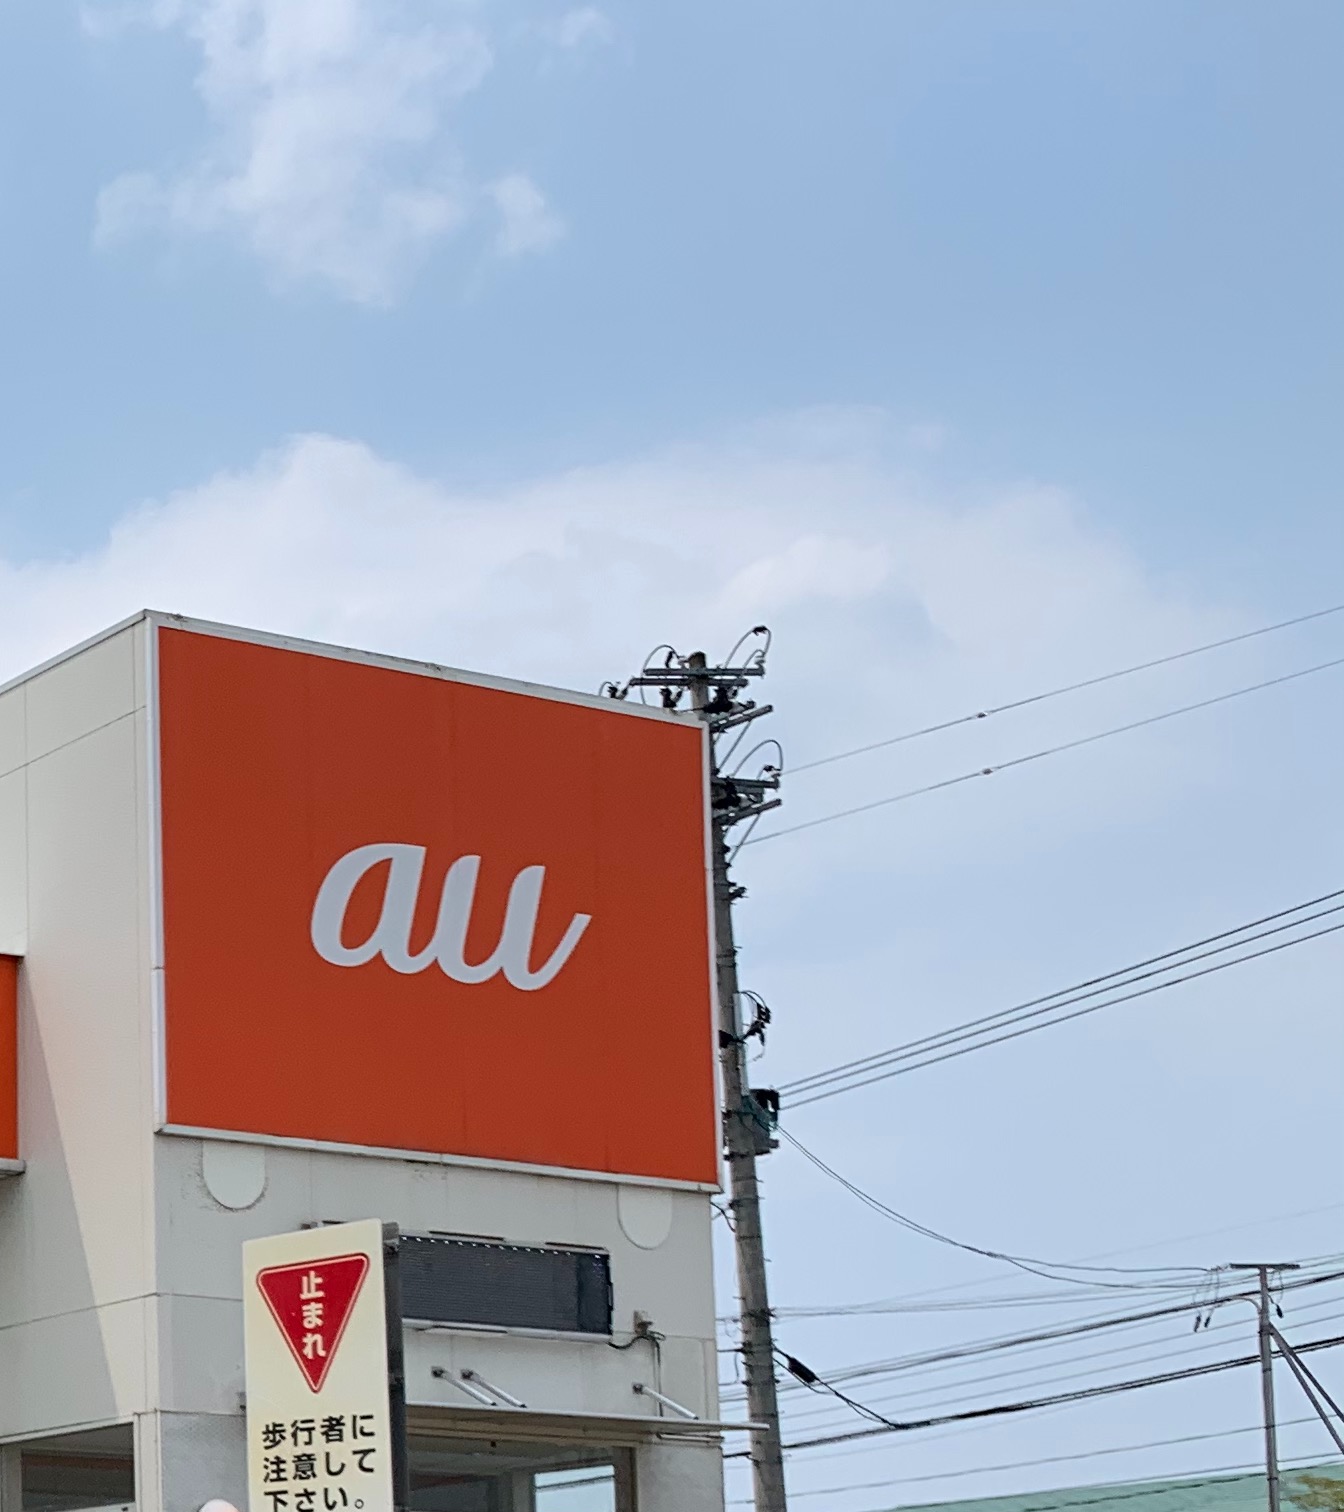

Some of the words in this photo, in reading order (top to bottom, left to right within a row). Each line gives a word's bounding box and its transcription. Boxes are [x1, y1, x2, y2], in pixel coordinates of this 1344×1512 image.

[311, 843, 592, 991] au
[299, 1270, 327, 1360] 止まれ
[261, 1414, 375, 1450] 歩行者に
[262, 1447, 376, 1483] 注意して
